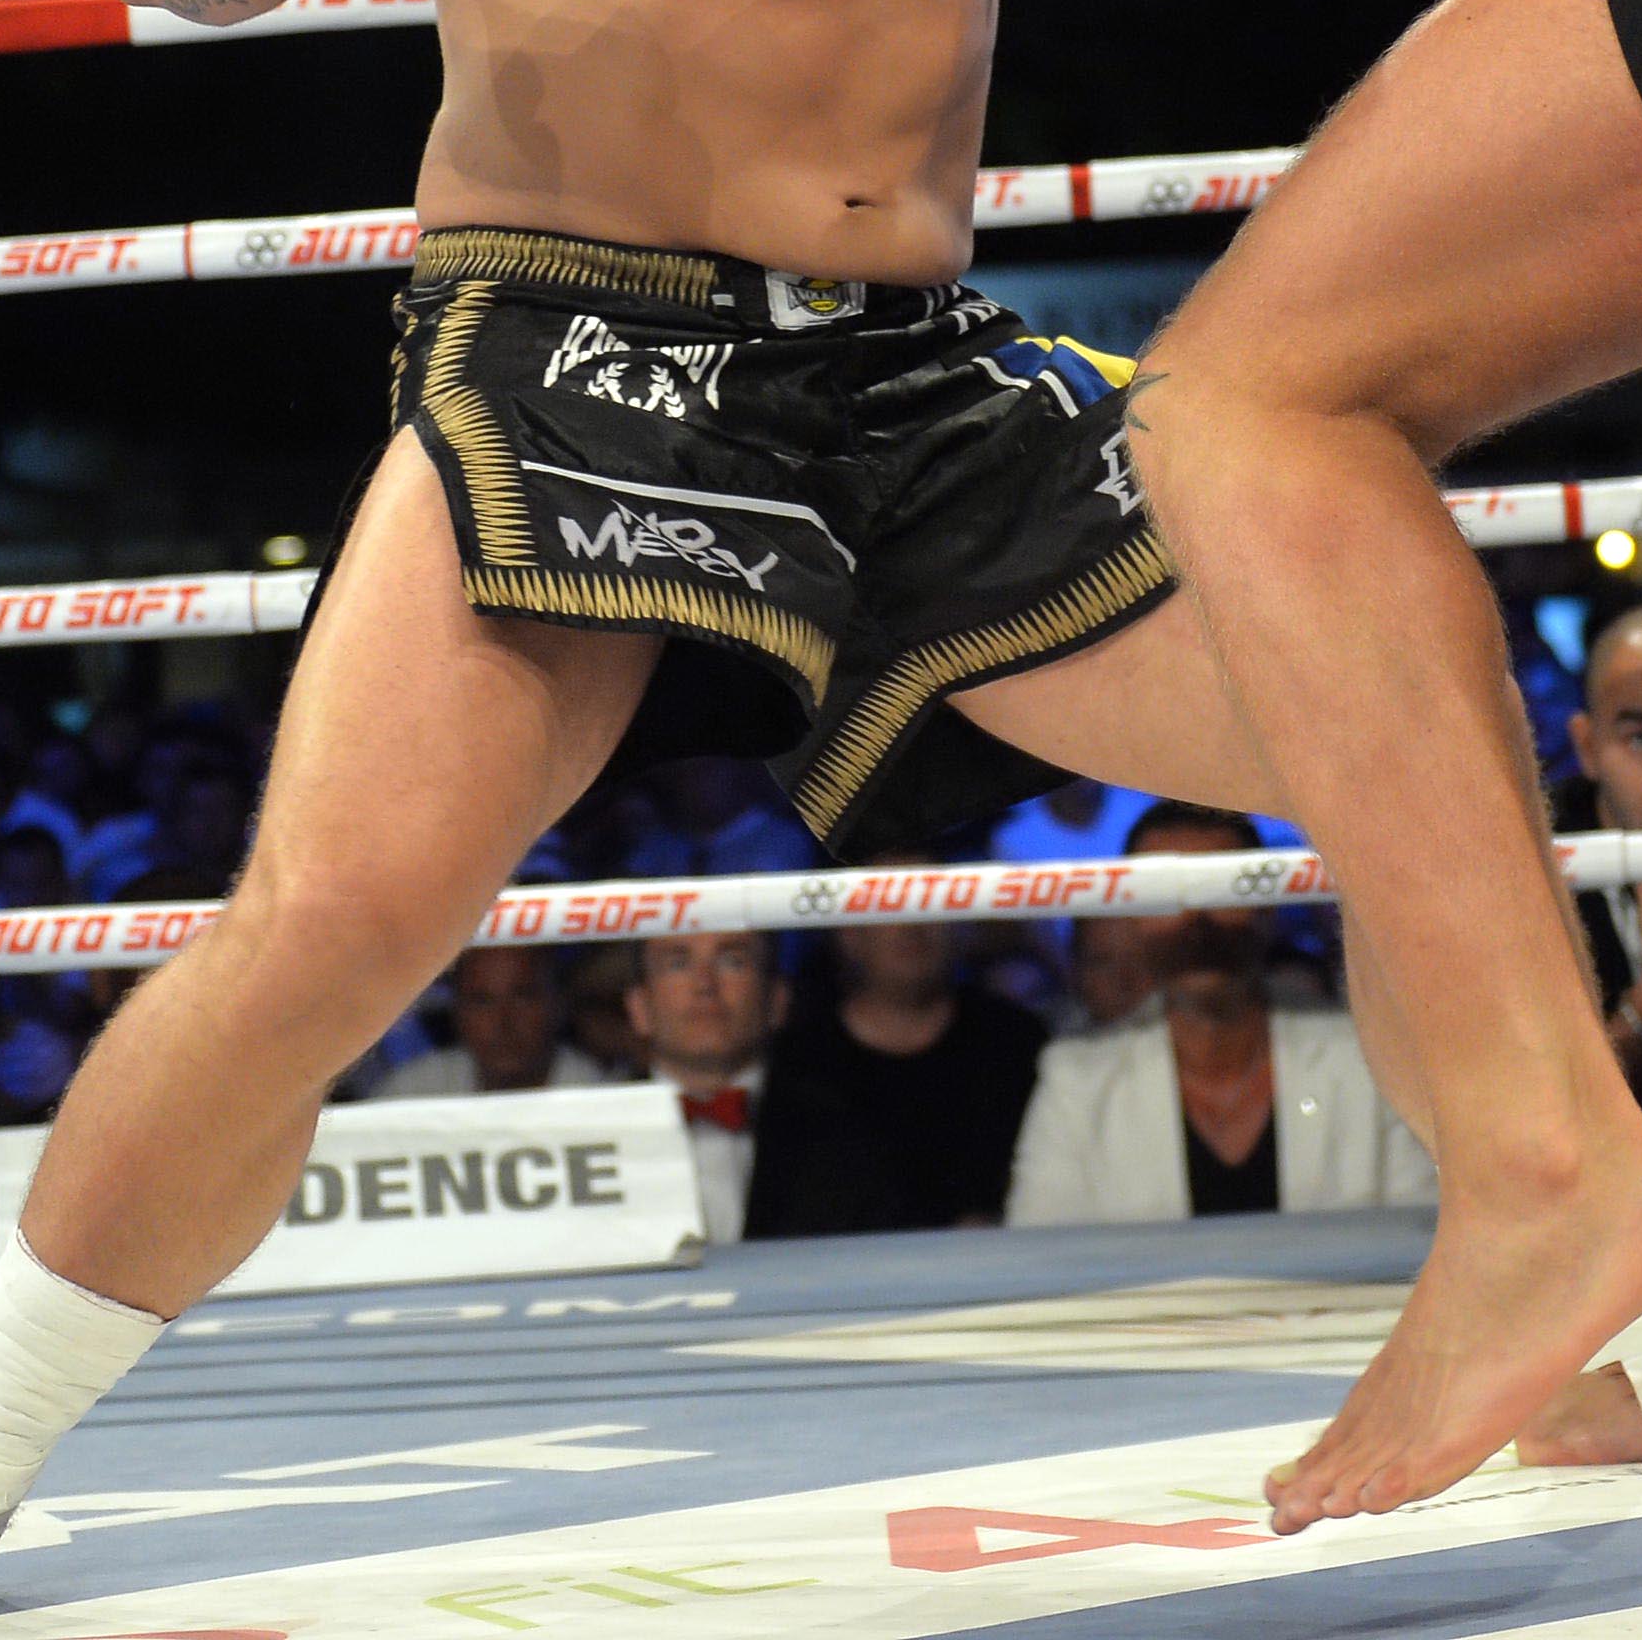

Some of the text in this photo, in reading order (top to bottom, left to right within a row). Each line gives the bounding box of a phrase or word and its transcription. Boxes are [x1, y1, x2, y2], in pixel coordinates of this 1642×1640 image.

[65, 586, 207, 629] SOFT
[843, 866, 1136, 913] AUTO SOFT
[560, 892, 700, 935] SOFT
[285, 1142, 624, 1228] DENCE
